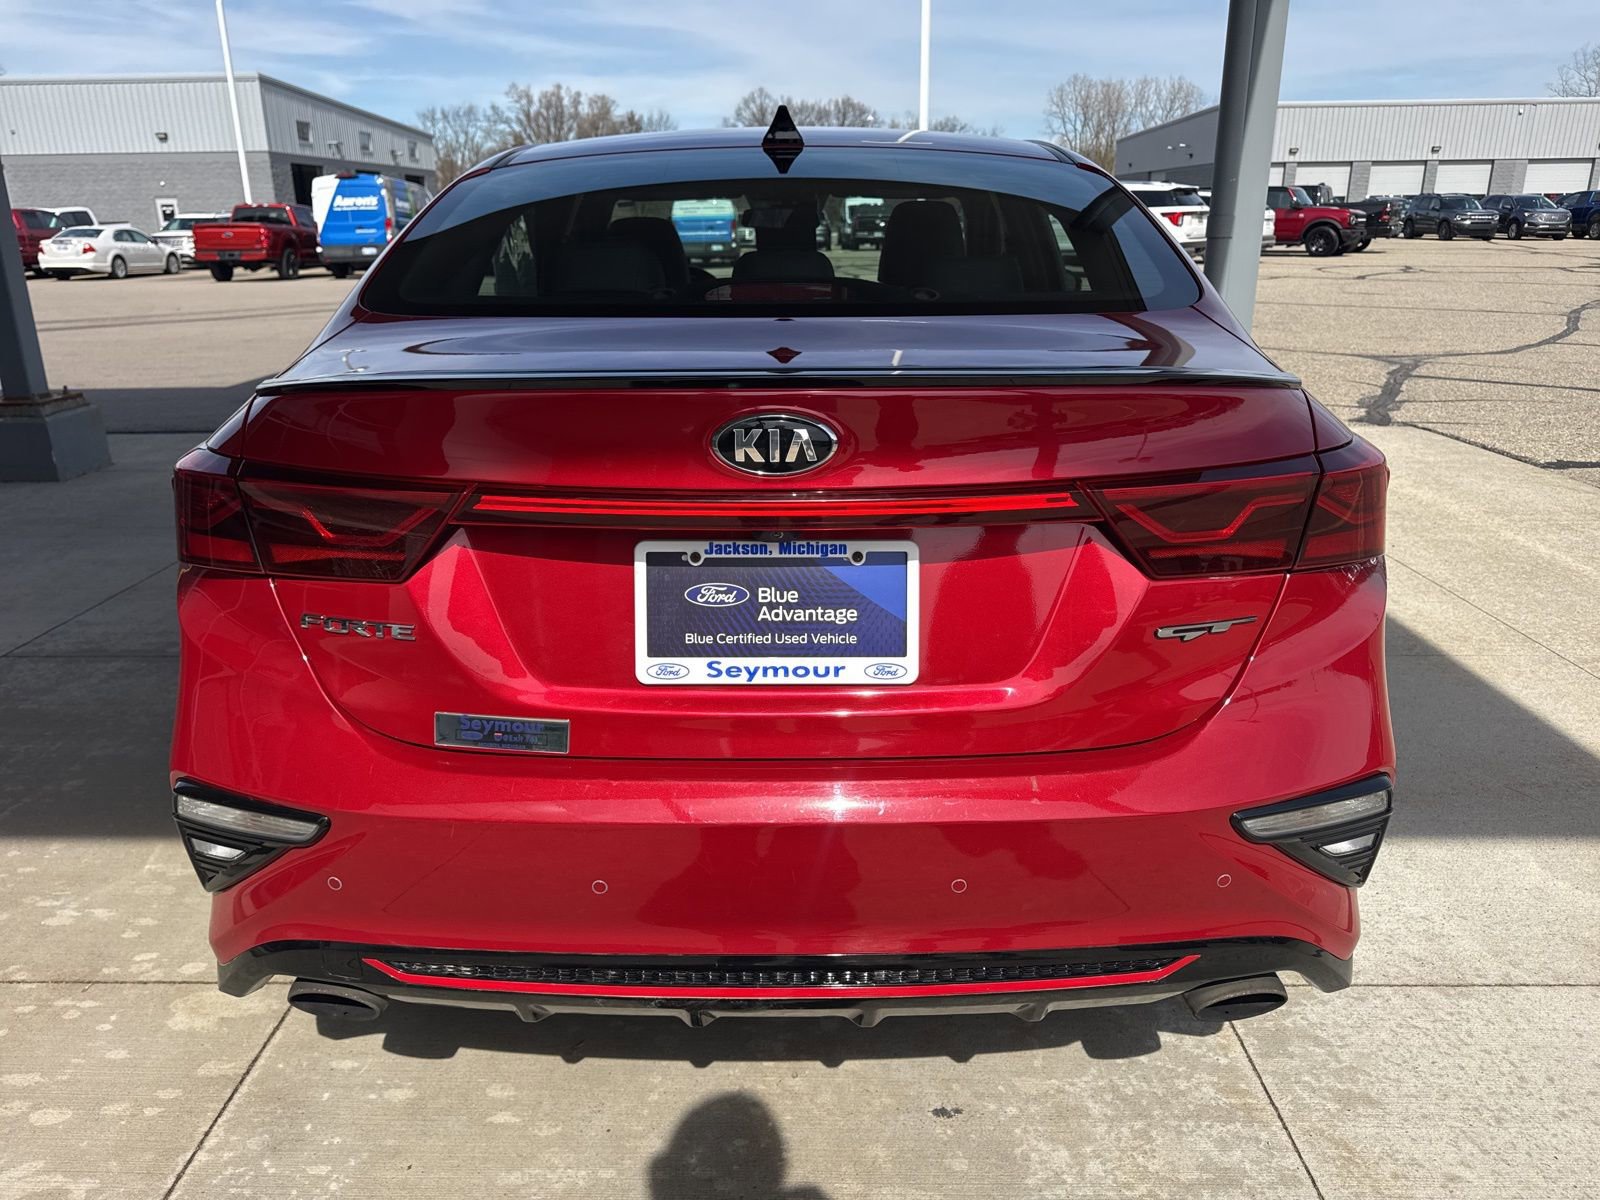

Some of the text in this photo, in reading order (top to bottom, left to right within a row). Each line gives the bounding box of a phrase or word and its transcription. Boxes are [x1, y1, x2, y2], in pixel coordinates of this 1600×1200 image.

[733, 428, 818, 463] KIA
[704, 541, 847, 558] Jackson, Michigan
[696, 582, 738, 604] Ford
[757, 587, 799, 603] Blue
[757, 606, 858, 624] Advantage
[300, 613, 416, 641] FORTE
[1154, 615, 1258, 642] GT
[685, 633, 857, 644] Blue Certified Used Vehicle
[654, 665, 681, 678] Ford
[706, 660, 846, 682] Seymour
[872, 665, 899, 678] Ford
[460, 715, 545, 734] Seymour
